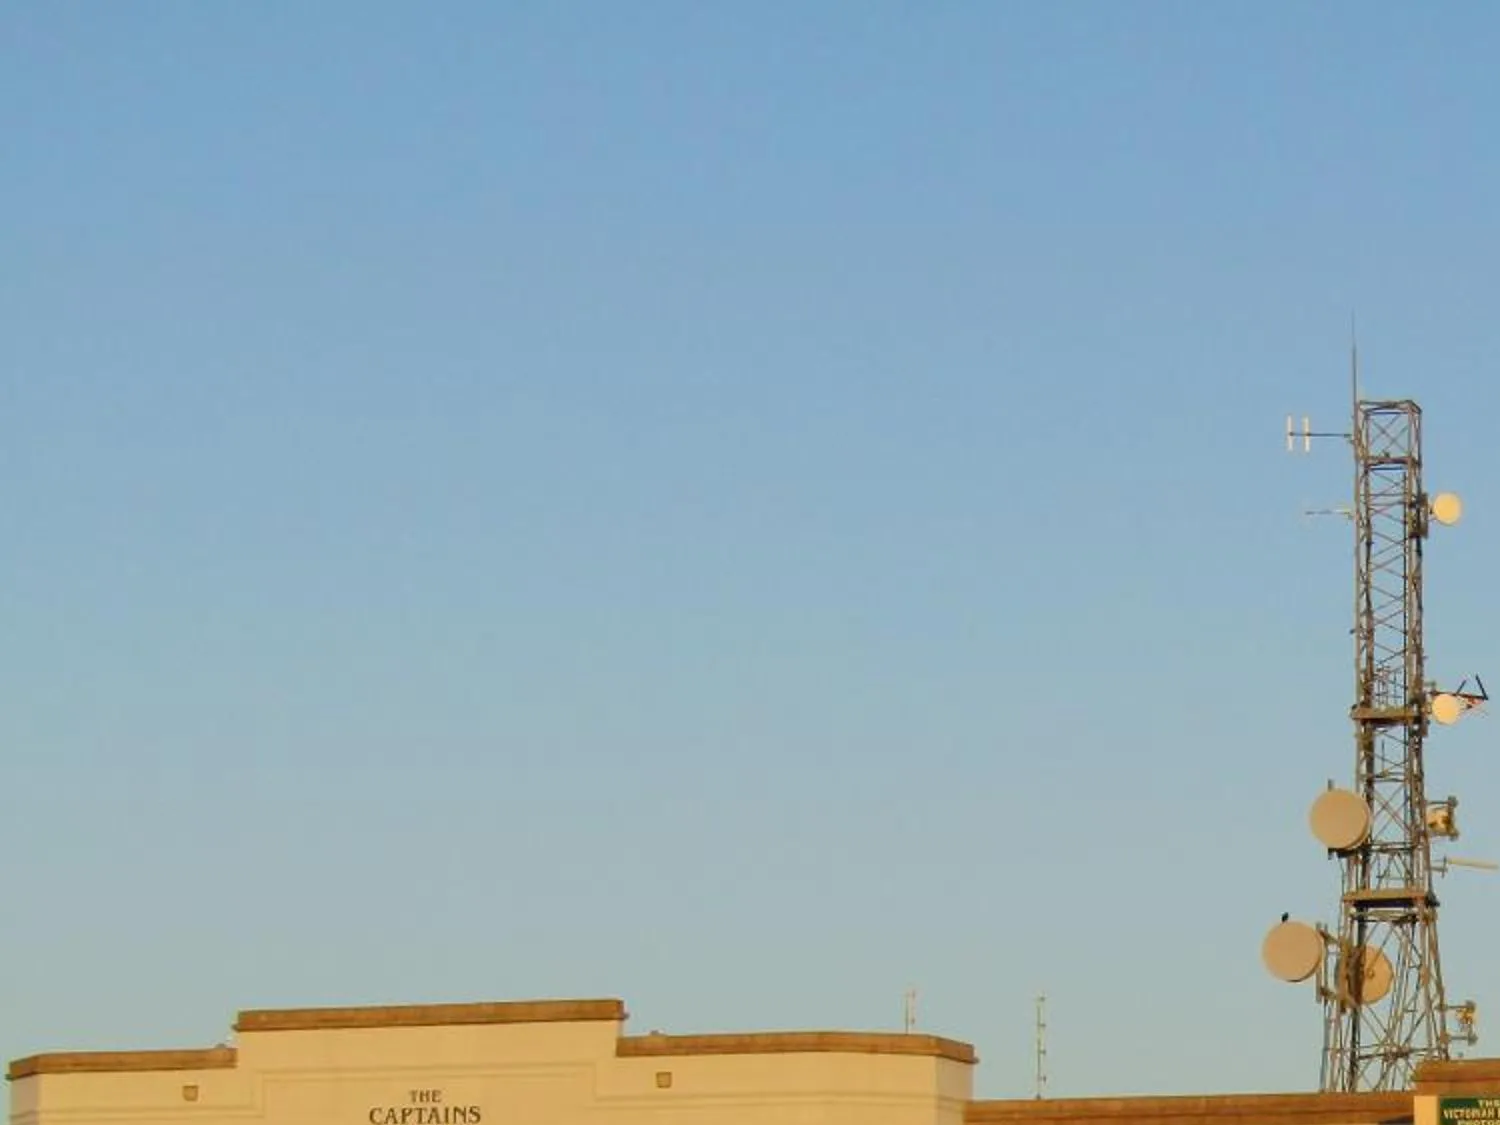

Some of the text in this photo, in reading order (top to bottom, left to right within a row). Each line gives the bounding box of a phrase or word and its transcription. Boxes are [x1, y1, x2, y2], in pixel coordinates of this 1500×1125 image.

[409, 1089, 442, 1103] THE
[1477, 1099, 1500, 1108] THE
[368, 1105, 482, 1125] CAPTAINS
[1443, 1108, 1495, 1119] VICTORIAN
